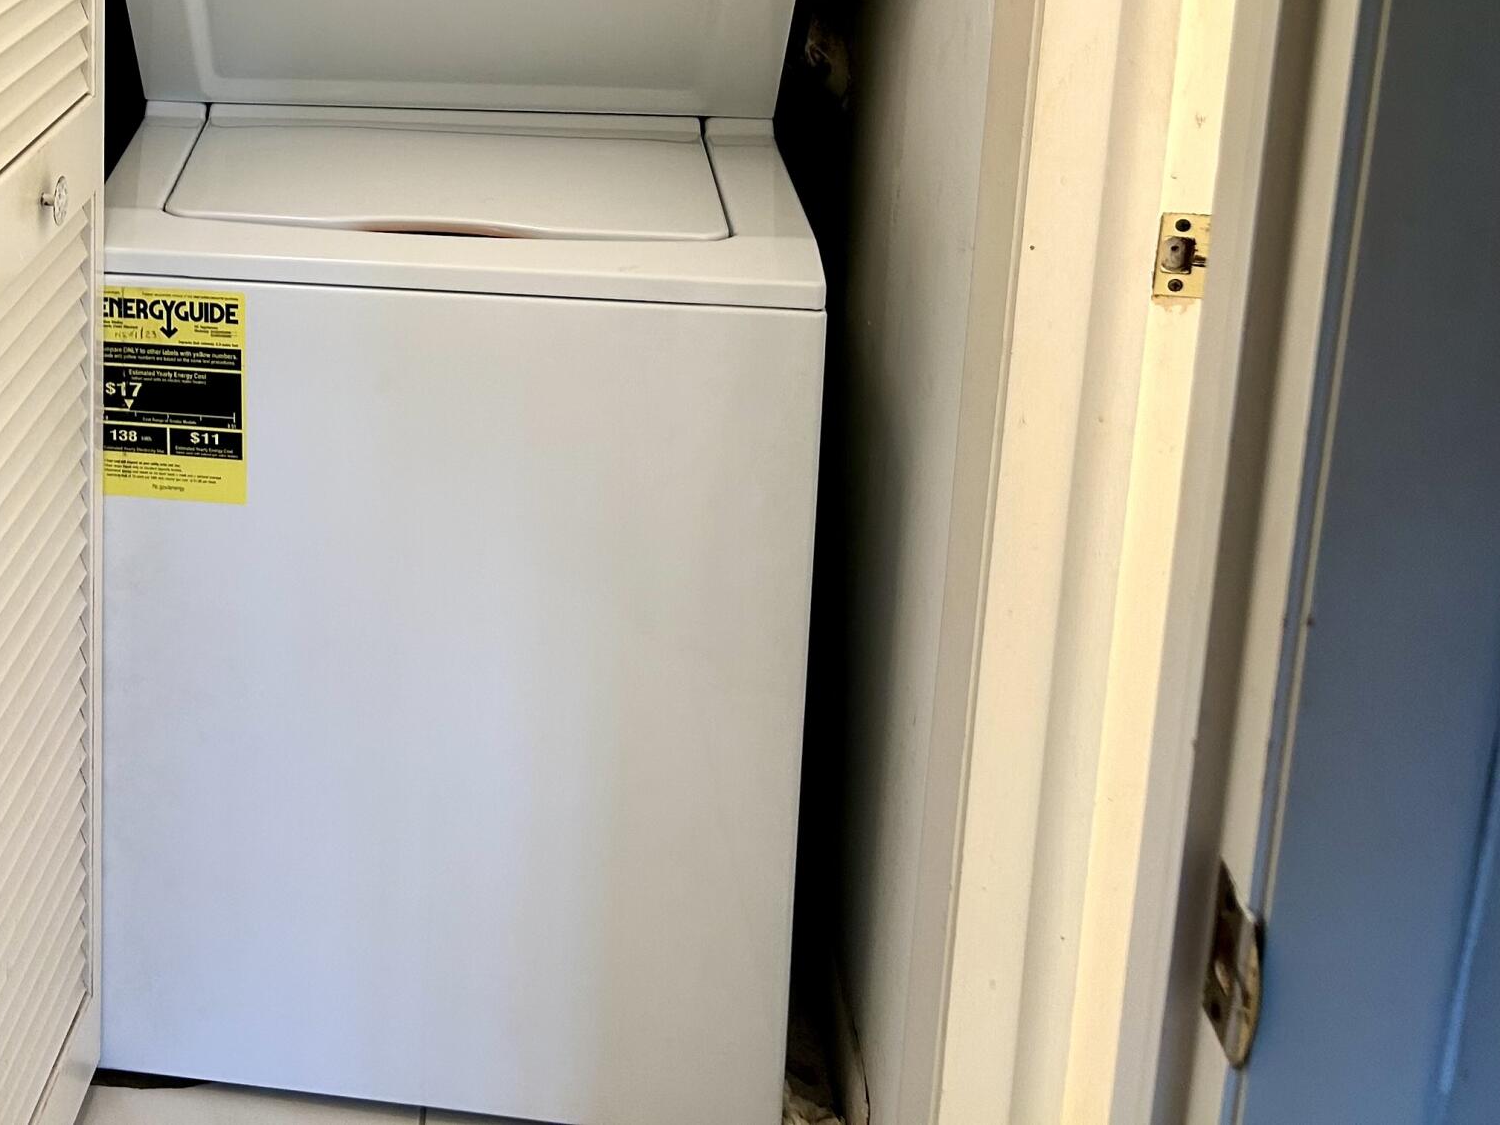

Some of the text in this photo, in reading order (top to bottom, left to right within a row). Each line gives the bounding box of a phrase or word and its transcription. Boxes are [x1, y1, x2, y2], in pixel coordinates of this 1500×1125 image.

[147, 348, 161, 356] other
[192, 351, 211, 359] yellow
[128, 368, 207, 380] Estimated Yearly Energy Cost
[105, 381, 143, 398] $17
[109, 428, 139, 443] 138
[189, 431, 220, 446] $11
